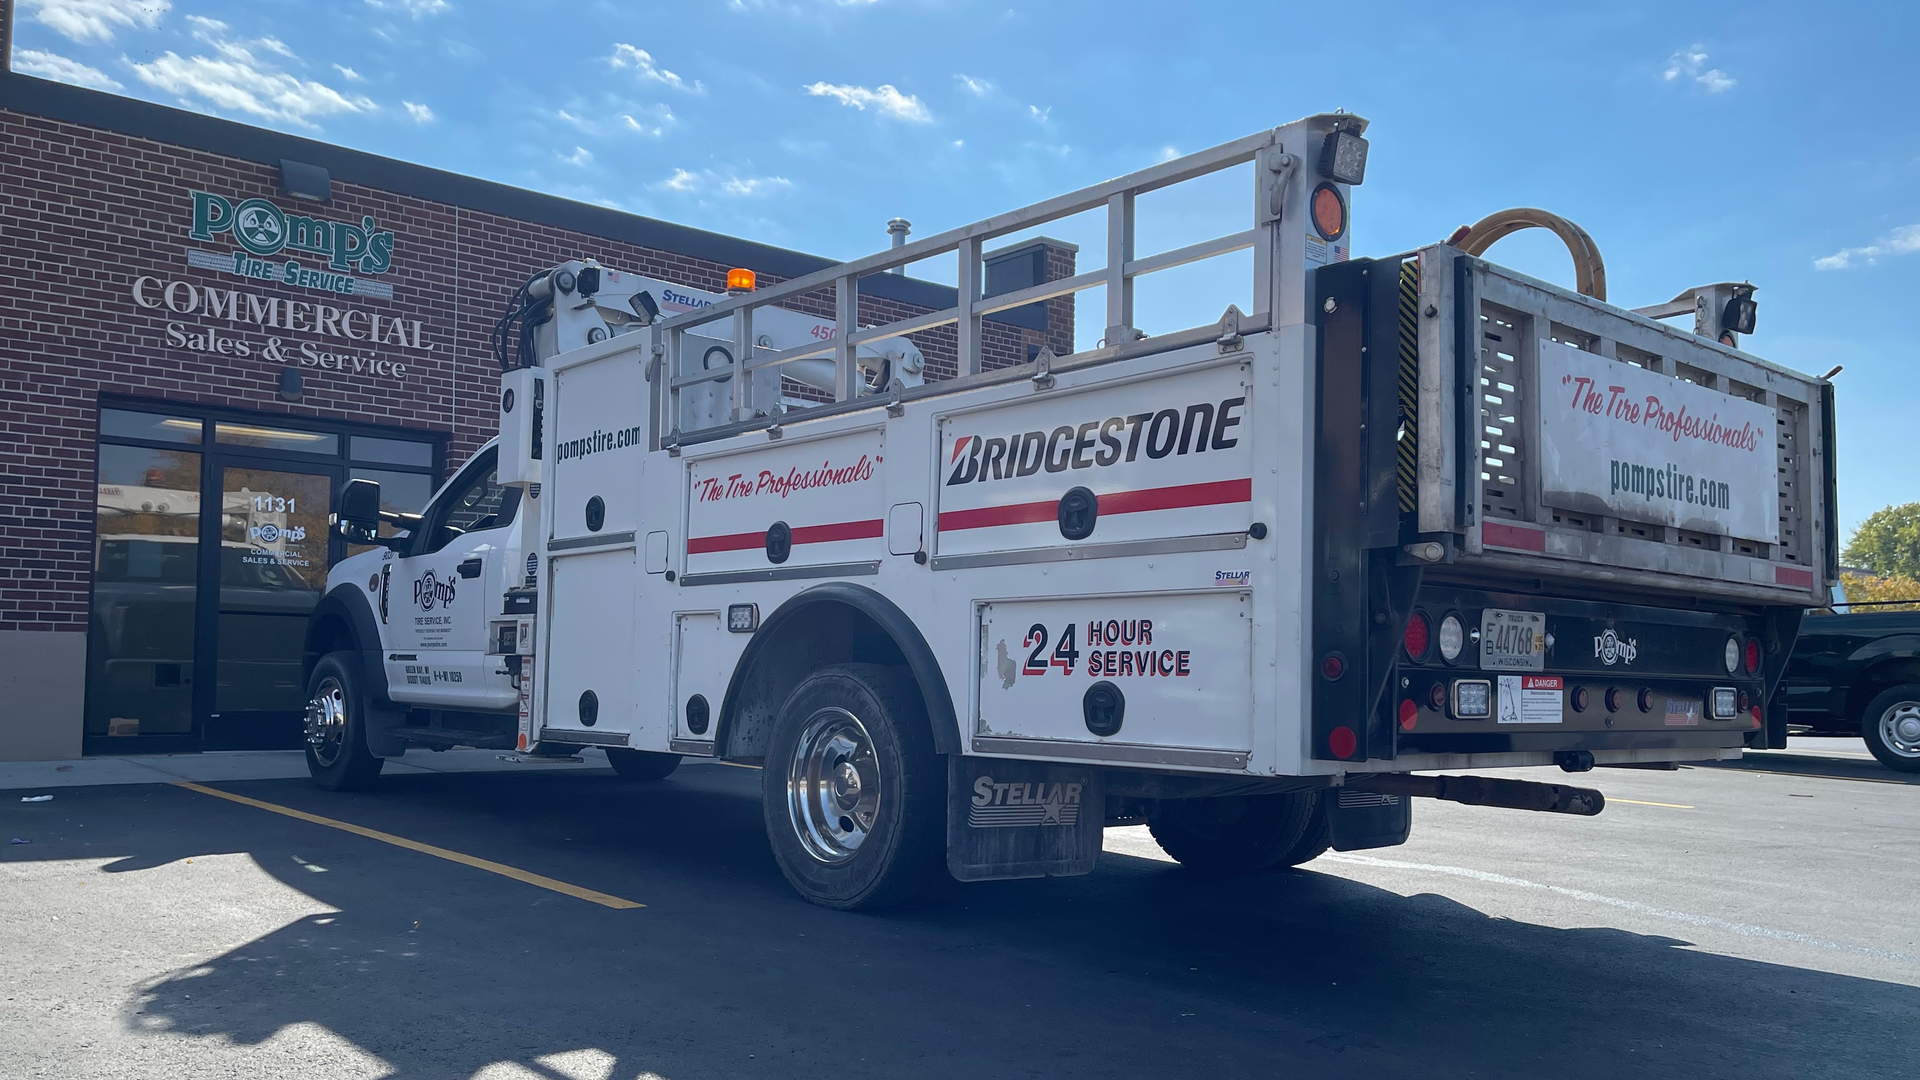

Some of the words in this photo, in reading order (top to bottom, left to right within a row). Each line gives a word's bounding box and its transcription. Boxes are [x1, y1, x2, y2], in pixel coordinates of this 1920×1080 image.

[233, 251, 273, 280] TIRE
[283, 257, 354, 294] SERVICE
[132, 275, 435, 350] COMMERCIAL
[165, 322, 250, 357] Sales
[262, 337, 289, 363] &
[300, 343, 406, 377] Service
[1607, 386, 1641, 424] Tire
[557, 426, 640, 465] pompstire.com
[946, 396, 1246, 486] BRIDGESTONE
[725, 473, 754, 499] Tire
[1610, 459, 1730, 510] pompstire.com
[254, 496, 296, 513] 1131
[242, 556, 268, 565] SALES
[269, 557, 276, 565] &
[277, 558, 310, 567] SERVICE
[250, 548, 303, 558] COMMERCIAL
[1215, 570, 1250, 580] STELLAR
[414, 617, 424, 625] TIRE
[1022, 623, 1080, 676] 24
[1088, 619, 1153, 646] HOUR
[1496, 624, 1533, 655] 44768
[1088, 650, 1191, 677] SERVICE
[1498, 658, 1530, 666] WISCONSIN
[1534, 679, 1558, 688] DANGER
[1666, 698, 1700, 714] STELLAR
[972, 776, 1083, 806] STELLAR
